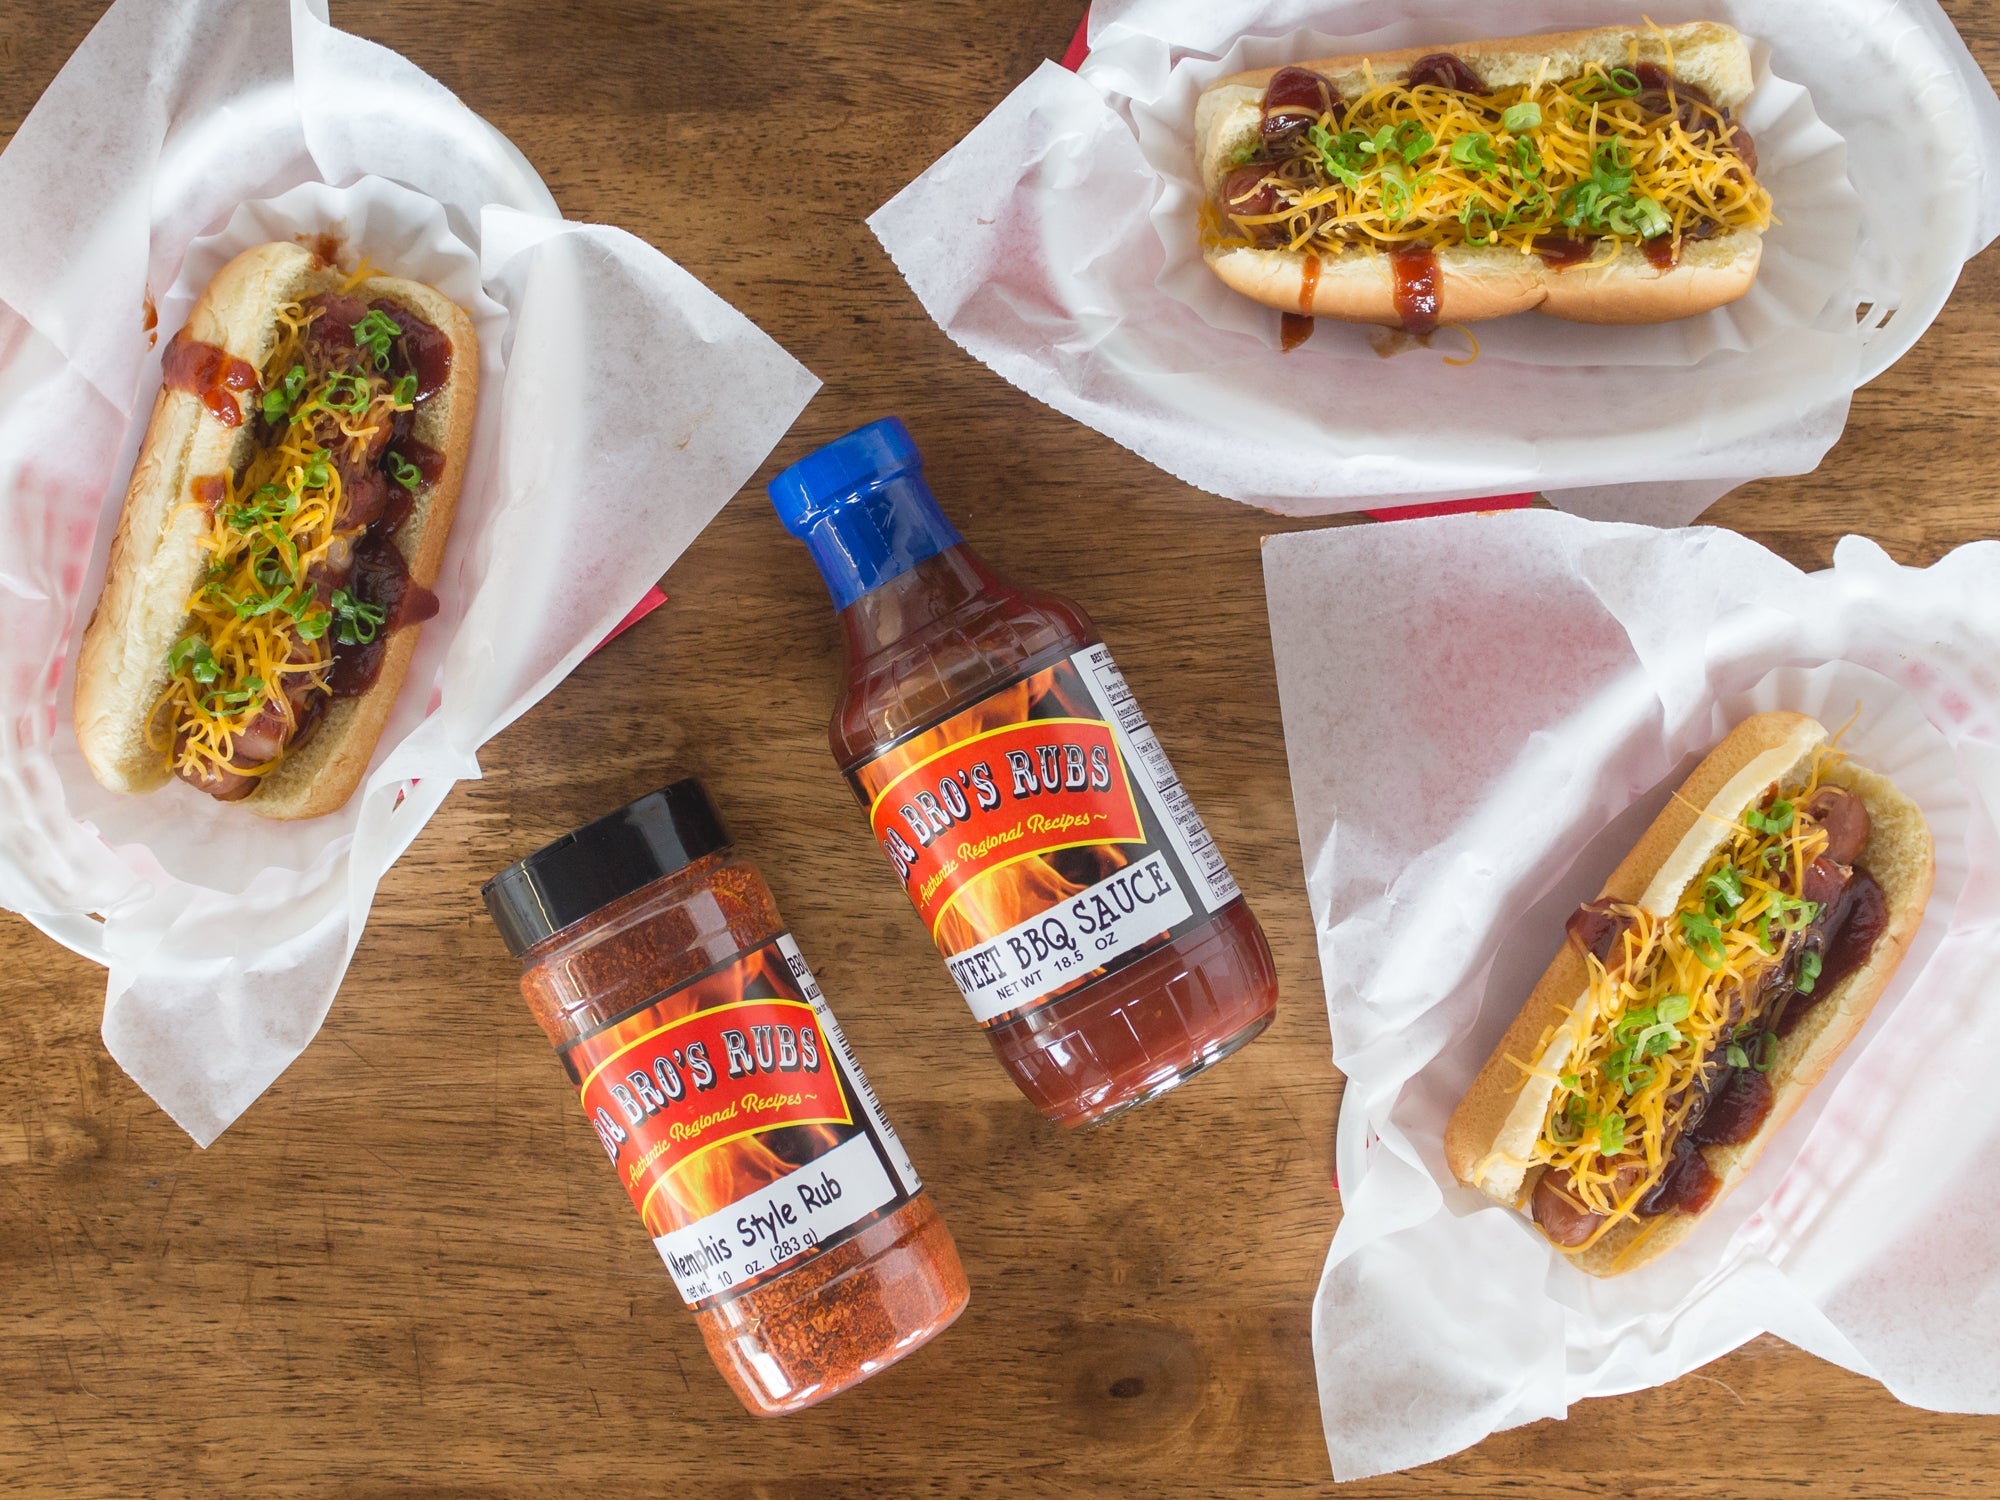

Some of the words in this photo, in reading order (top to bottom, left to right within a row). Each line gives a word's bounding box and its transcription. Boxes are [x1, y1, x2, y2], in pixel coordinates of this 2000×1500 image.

[900, 762, 1001, 848] BRO'S
[1006, 744, 1112, 800] RUBS
[920, 858, 959, 907] Authentic
[957, 822, 1024, 862] Regional
[1027, 813, 1090, 835] Recipes
[950, 945, 1007, 995] SWEET
[1007, 917, 1076, 970] BBQ
[1072, 861, 1172, 934] SAUCE
[996, 981, 1020, 1000] NET
[1020, 970, 1043, 988] WT
[1054, 949, 1084, 972] 18.5
[1095, 932, 1119, 950] OZ
[610, 1041, 717, 1128] BRO'S
[721, 1024, 821, 1081] RUBS
[629, 1139, 671, 1188] Authentic
[669, 1101, 738, 1142] Regional
[741, 1093, 802, 1113] Recipes
[667, 1235, 733, 1280] Memphis
[736, 1199, 797, 1247] Style
[797, 1171, 842, 1214] Rub
[686, 1284, 699, 1299] net
[697, 1280, 712, 1295] wt.
[717, 1271, 733, 1288] 10
[745, 1260, 765, 1276] oz.
[770, 1236, 801, 1265] (283
[802, 1227, 820, 1248] g)
